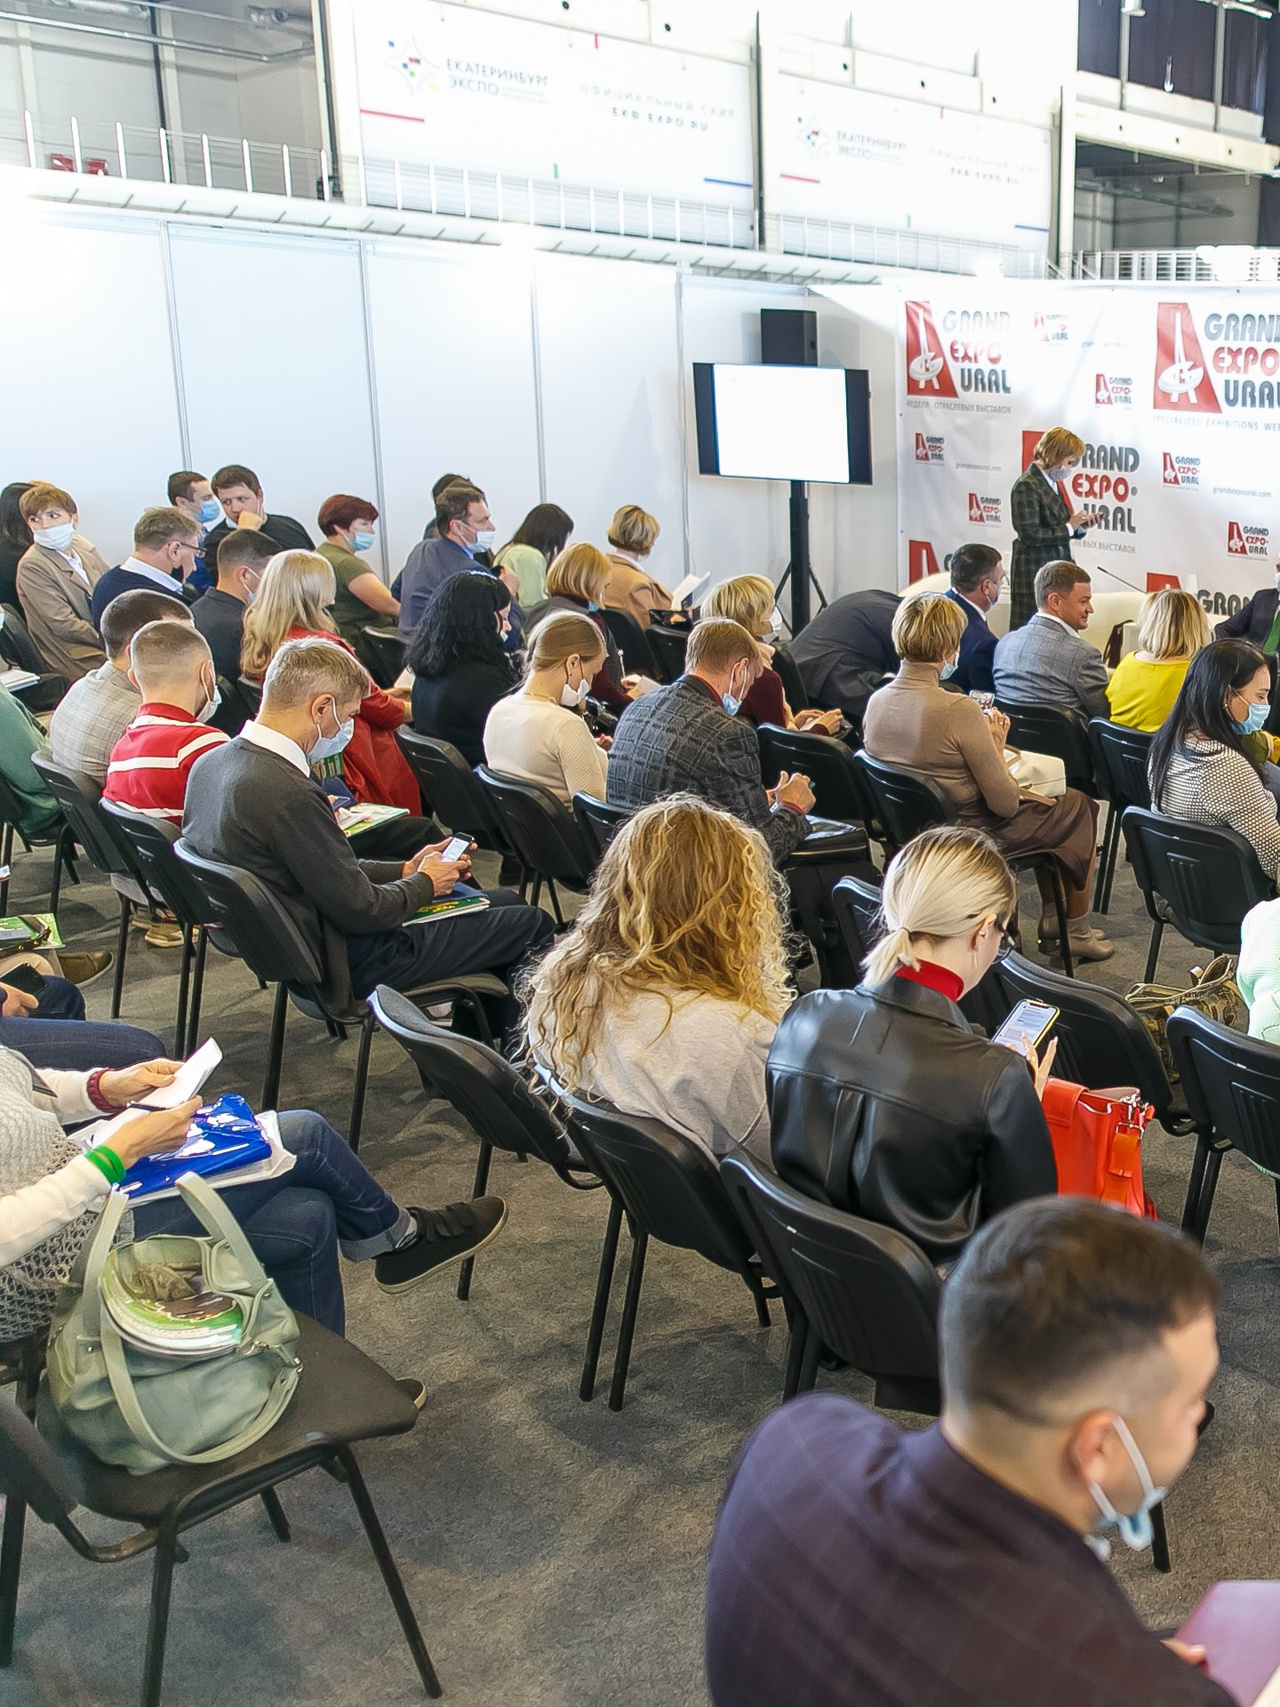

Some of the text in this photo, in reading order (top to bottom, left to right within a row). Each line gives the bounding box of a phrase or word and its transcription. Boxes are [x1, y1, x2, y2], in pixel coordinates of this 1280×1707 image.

[446, 57, 548, 87] ЕКАТЕРИНБУРГ
[448, 75, 499, 96] ЭКСПО
[943, 309, 1012, 333] GRAND
[950, 340, 1002, 365] EXPO
[1212, 346, 1280, 377] EXPO
[960, 367, 1011, 394] URAL
[1111, 386, 1130, 395] EXPO
[1114, 396, 1132, 404] URAL
[906, 400, 1012, 415] НЕДЕЛЯ ОТРАСЛЕВЫХ ВЫСТАВОК
[1206, 418, 1259, 430] EXHIBITIONS
[1175, 456, 1201, 466] GRAND
[1177, 466, 1198, 475] EXPO
[1180, 475, 1200, 485] URAL
[1071, 473, 1130, 503] EXPO
[1243, 526, 1269, 536] GRAND
[1246, 536, 1266, 545] EXPO
[1098, 541, 1136, 554] ВЫСТАВОК
[1249, 546, 1268, 555] URAL
[1197, 589, 1250, 616] GRA
